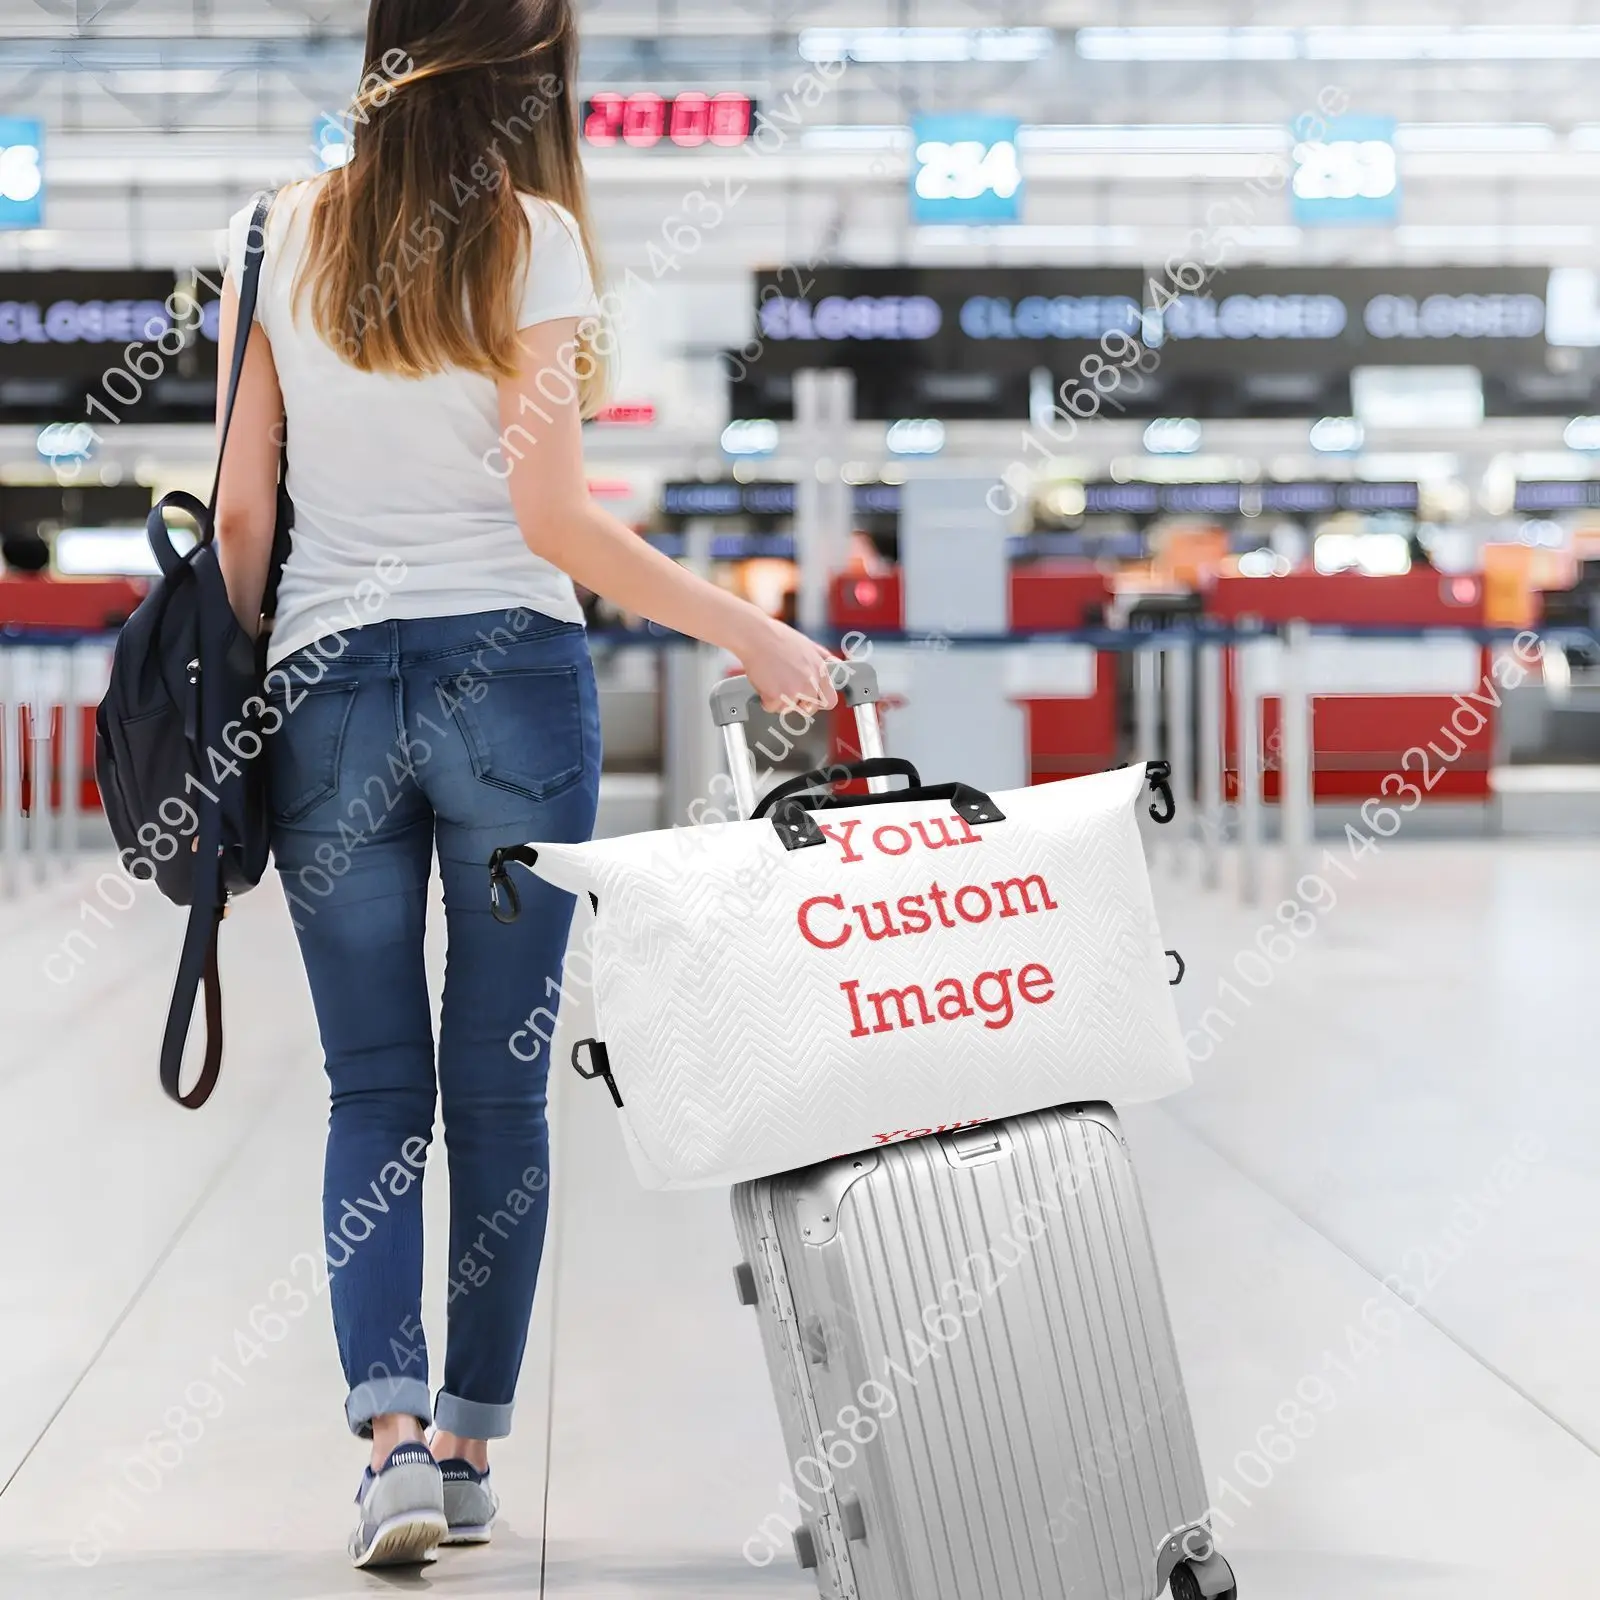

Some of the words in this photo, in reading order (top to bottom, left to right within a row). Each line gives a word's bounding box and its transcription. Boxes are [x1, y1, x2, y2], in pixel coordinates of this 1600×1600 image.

[760, 296, 942, 340] CLOSED
[960, 296, 1141, 340] CLOSED
[1165, 294, 1347, 339] CLOSED
[1363, 293, 1546, 338] CLOSED
[817, 816, 983, 864] Your
[797, 874, 1059, 950] Custom
[839, 962, 1056, 1038] Image
